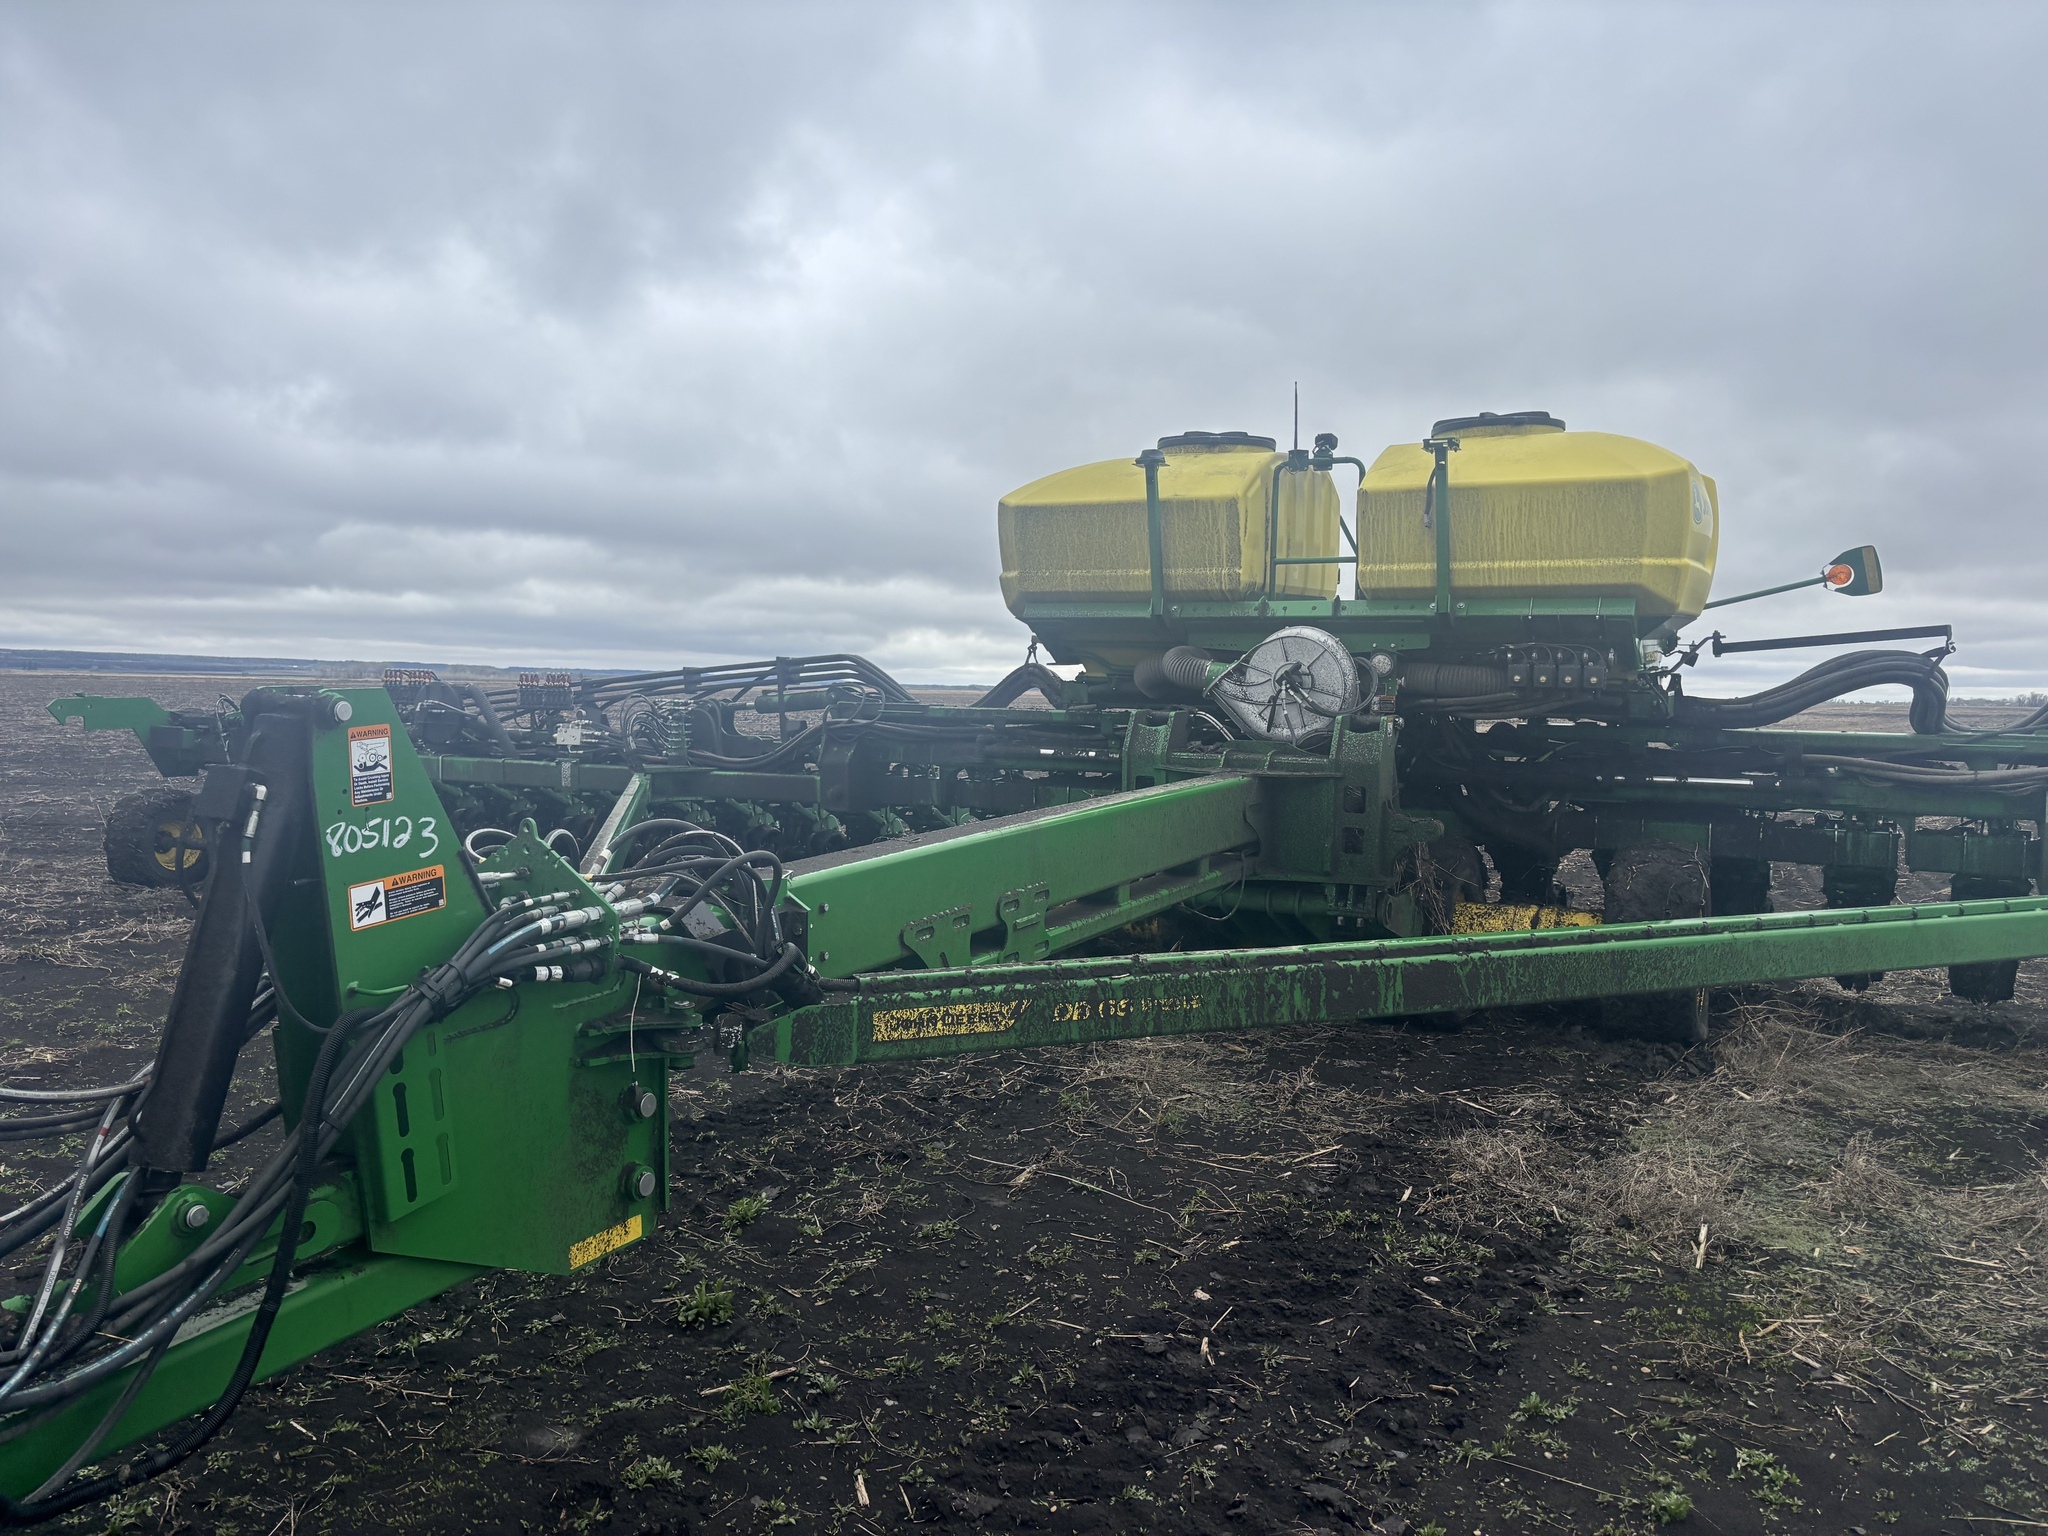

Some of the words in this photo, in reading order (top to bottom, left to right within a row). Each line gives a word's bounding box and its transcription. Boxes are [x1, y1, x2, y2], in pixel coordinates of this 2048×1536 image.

[356, 728, 388, 738] WARNING
[325, 816, 439, 858] 805123
[398, 868, 437, 884] WARNING
[889, 1013, 938, 1031] JOHN
[941, 1010, 1003, 1028] DEERE
